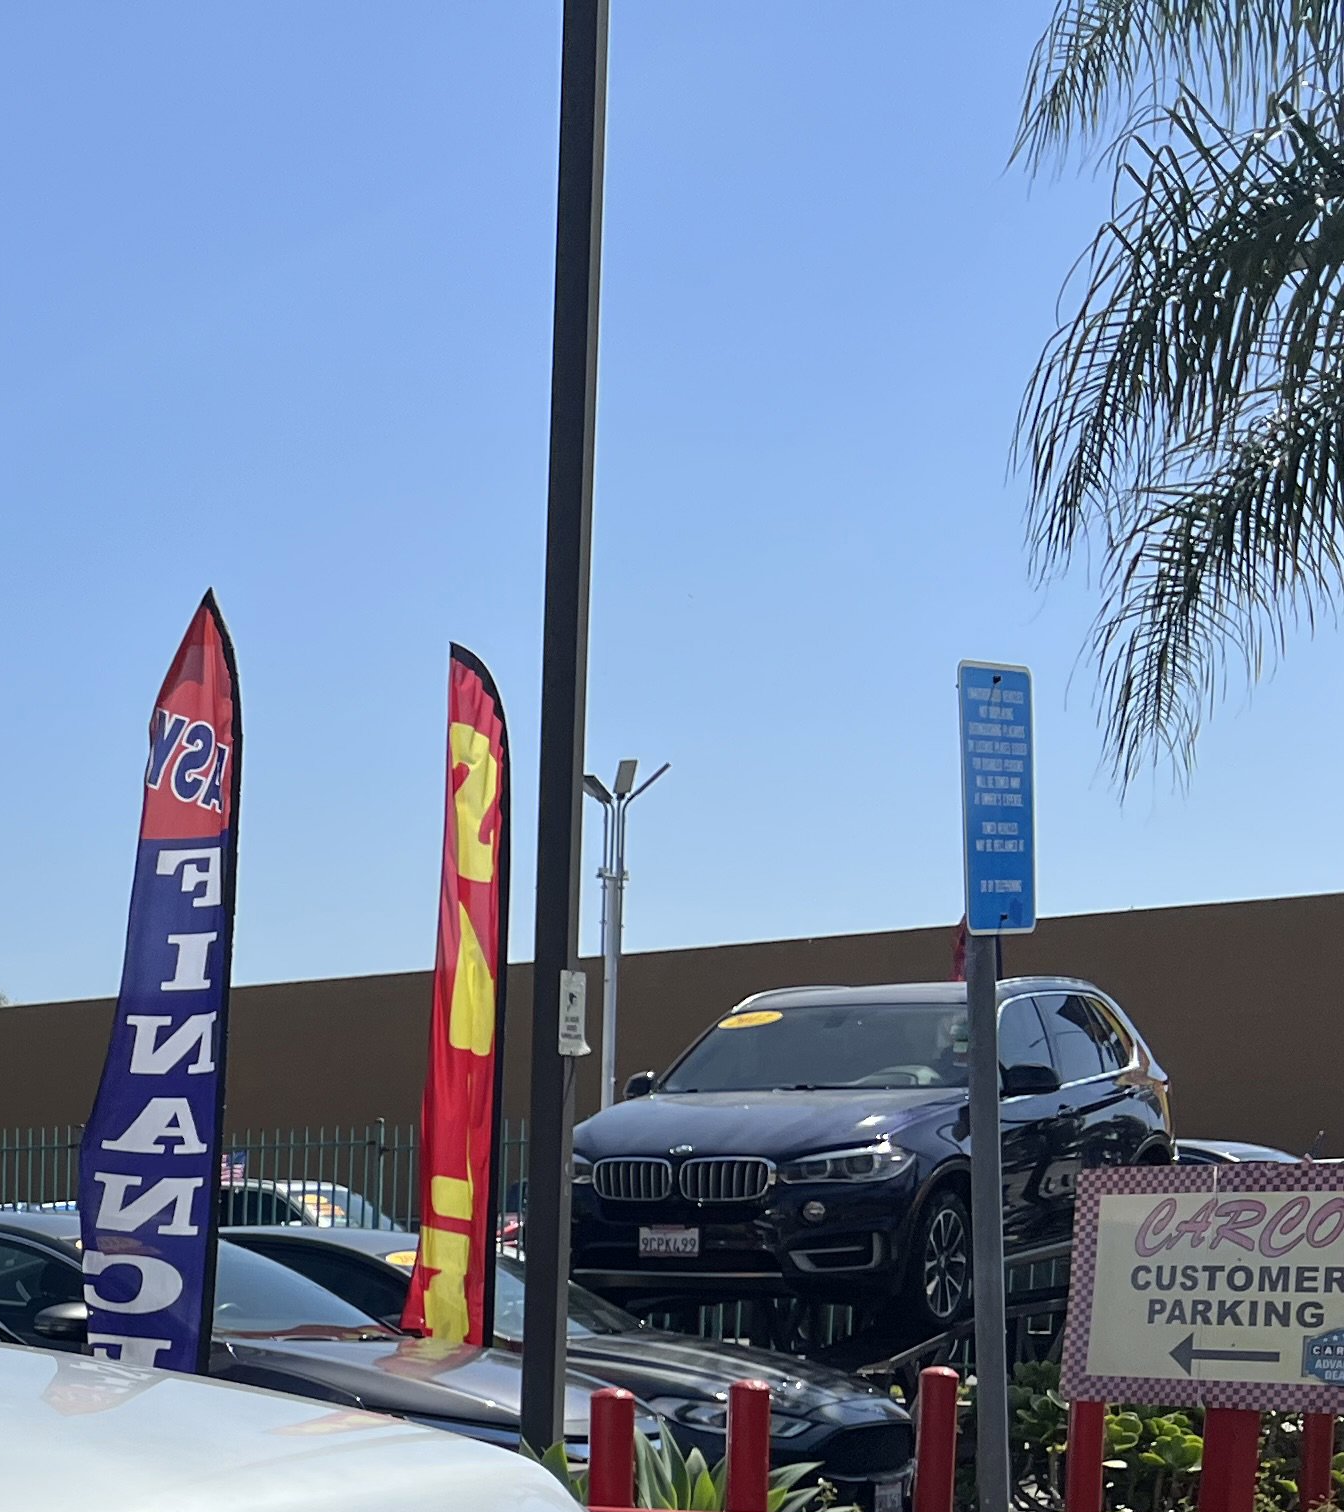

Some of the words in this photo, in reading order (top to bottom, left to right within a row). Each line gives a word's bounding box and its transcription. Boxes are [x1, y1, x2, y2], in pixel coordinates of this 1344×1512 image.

[1135, 1196, 1344, 1259] CARCO
[1130, 1265, 1344, 1293] CUSTOMER
[1147, 1298, 1325, 1328] PARKING
